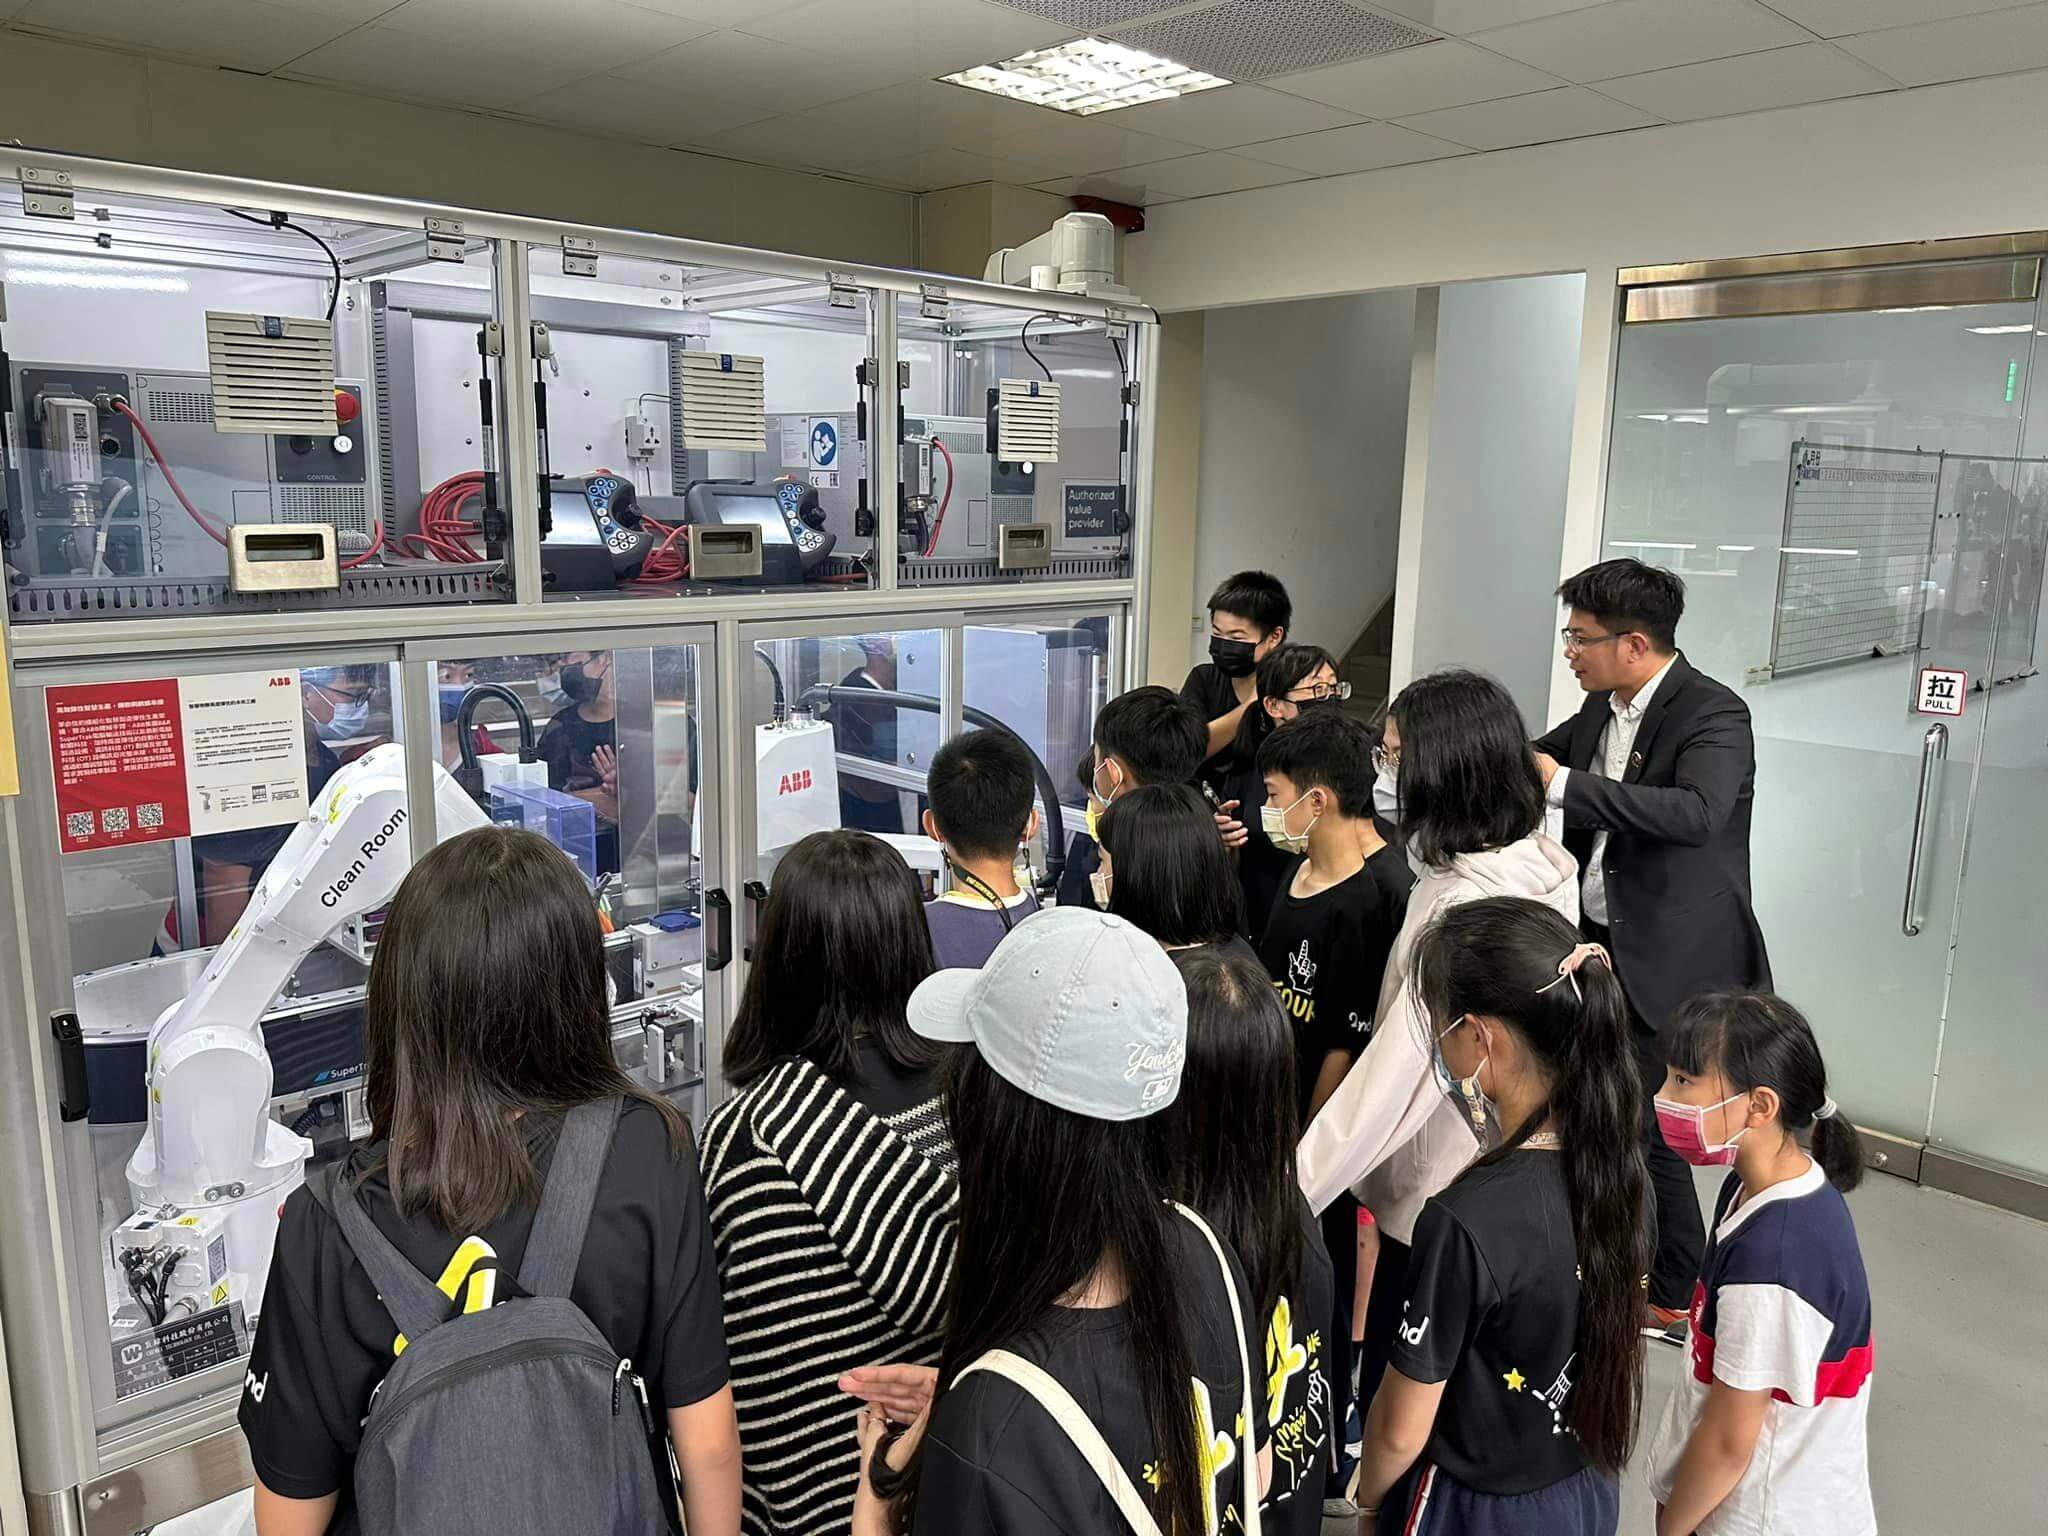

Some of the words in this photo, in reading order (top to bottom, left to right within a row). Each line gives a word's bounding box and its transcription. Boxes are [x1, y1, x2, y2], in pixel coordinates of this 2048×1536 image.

[1068, 489, 1115, 501] Authorized
[1068, 503, 1092, 515] value
[1068, 517, 1104, 531] provider
[269, 677, 291, 687] ABB
[1927, 674, 1956, 699] 拉
[1925, 699, 1953, 711] PULL
[779, 769, 812, 795] ABB
[321, 860, 366, 908] Clean
[360, 808, 407, 860] Room
